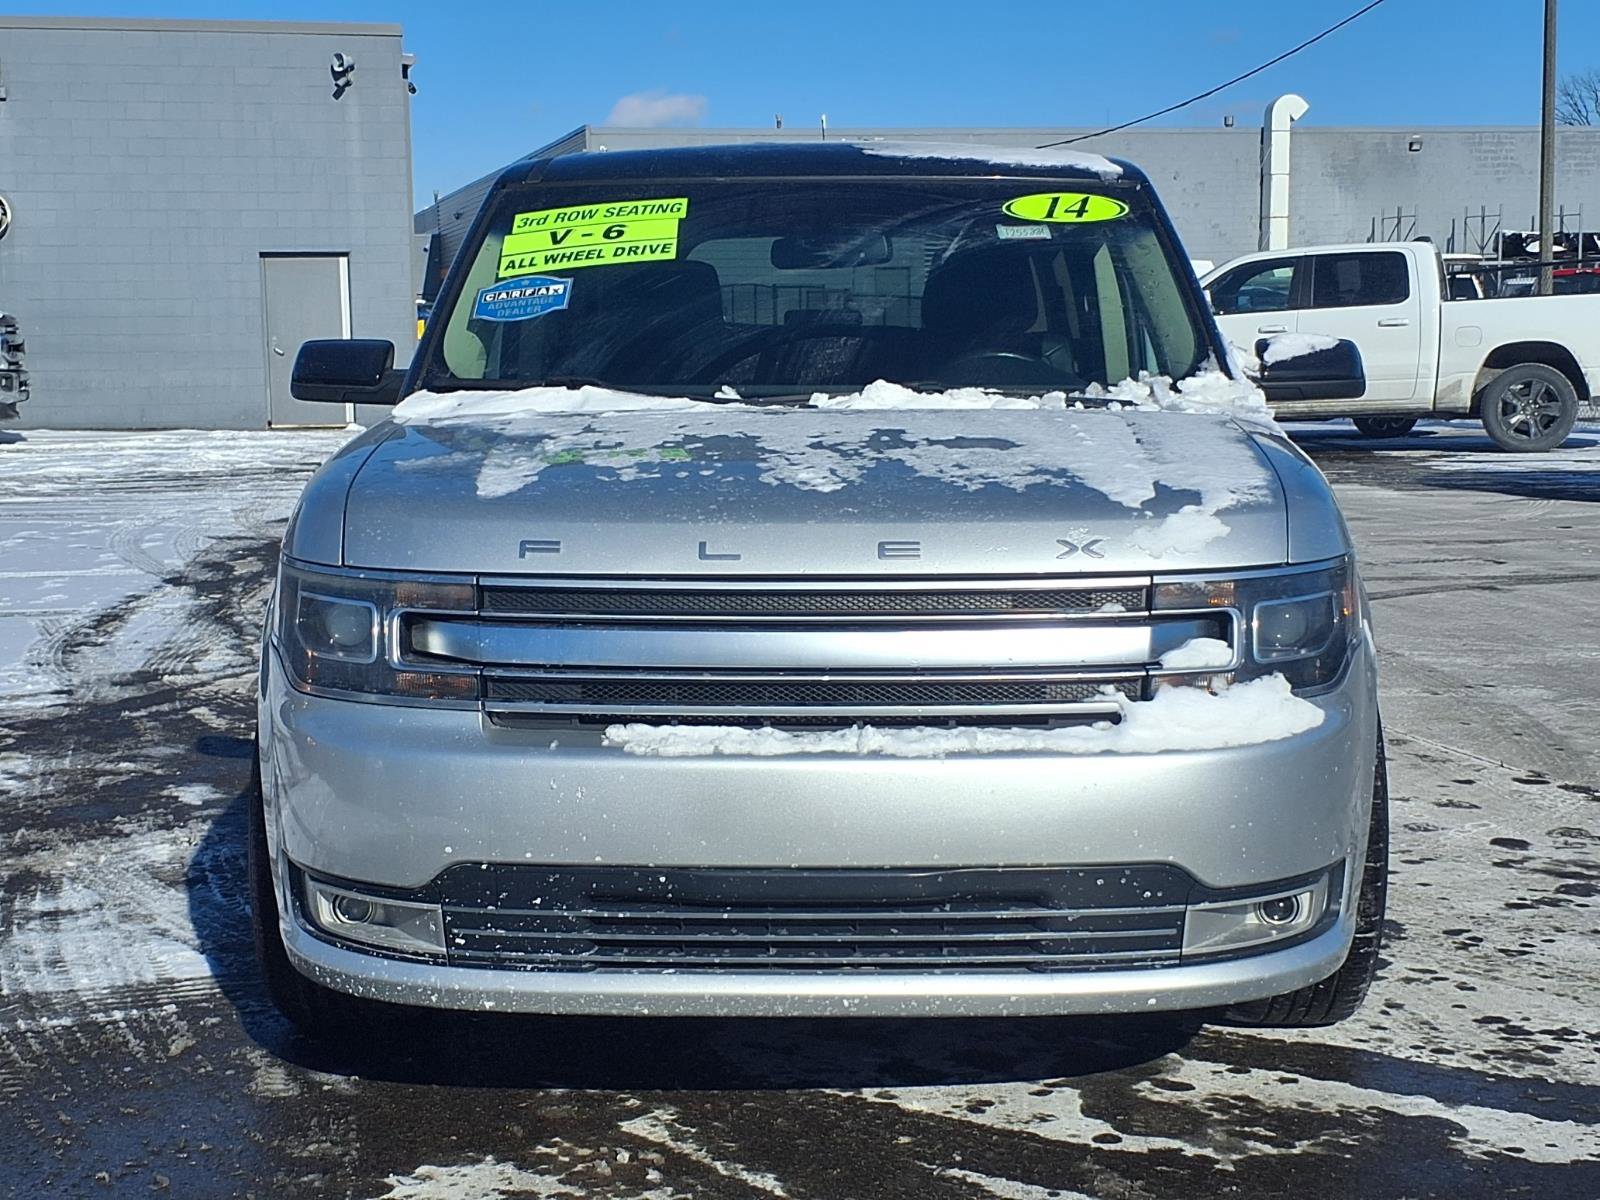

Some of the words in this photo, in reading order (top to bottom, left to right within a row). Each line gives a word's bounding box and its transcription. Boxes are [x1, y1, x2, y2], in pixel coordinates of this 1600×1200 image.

[516, 214, 550, 229] 3rd
[553, 208, 600, 224] ROW
[603, 202, 683, 218] SEATING
[1042, 195, 1091, 220] 14
[503, 256, 538, 271] ALL
[544, 248, 606, 265] WHEEL
[612, 242, 674, 258] DRIVE
[483, 285, 565, 303] CARFAX
[487, 296, 556, 311] ADVANTAGE
[496, 305, 542, 318] DEALER
